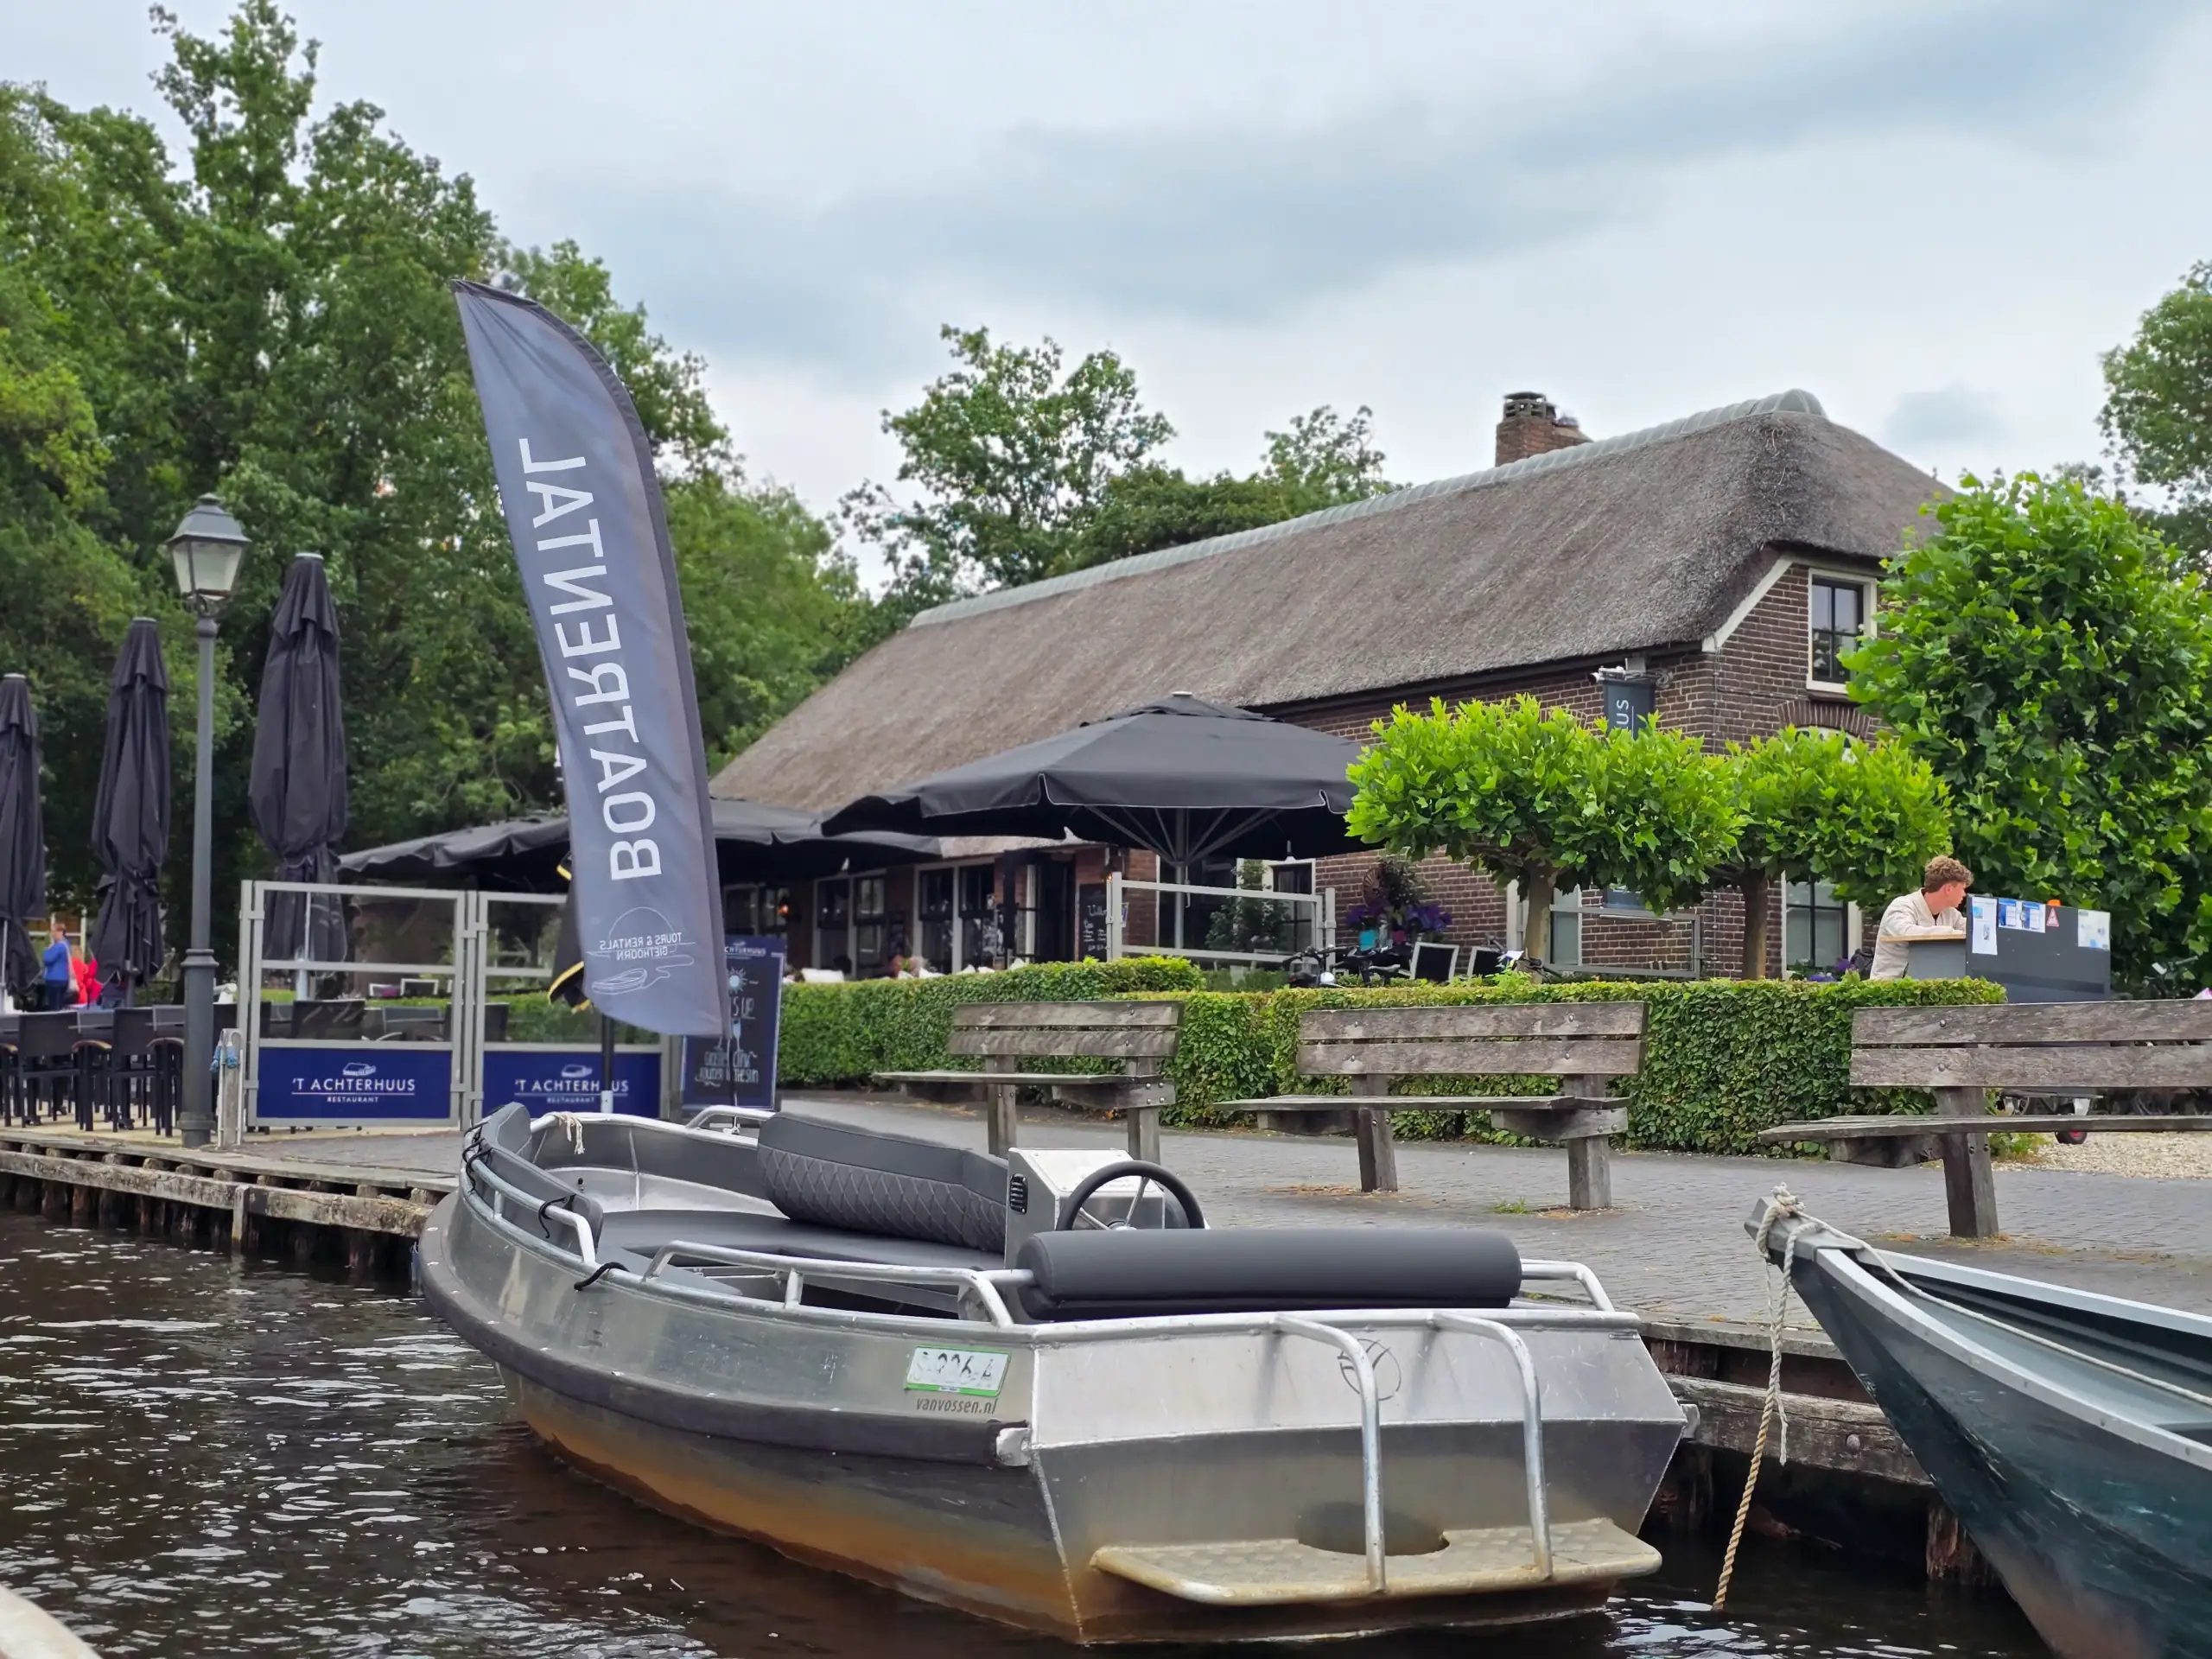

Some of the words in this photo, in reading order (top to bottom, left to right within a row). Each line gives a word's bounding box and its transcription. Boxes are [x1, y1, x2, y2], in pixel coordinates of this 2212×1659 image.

[310, 1077, 416, 1091] ACHTERHUUS
[531, 1079, 629, 1092] ACHTERHUS
[916, 1397, 999, 1415] vanvossen.nl
